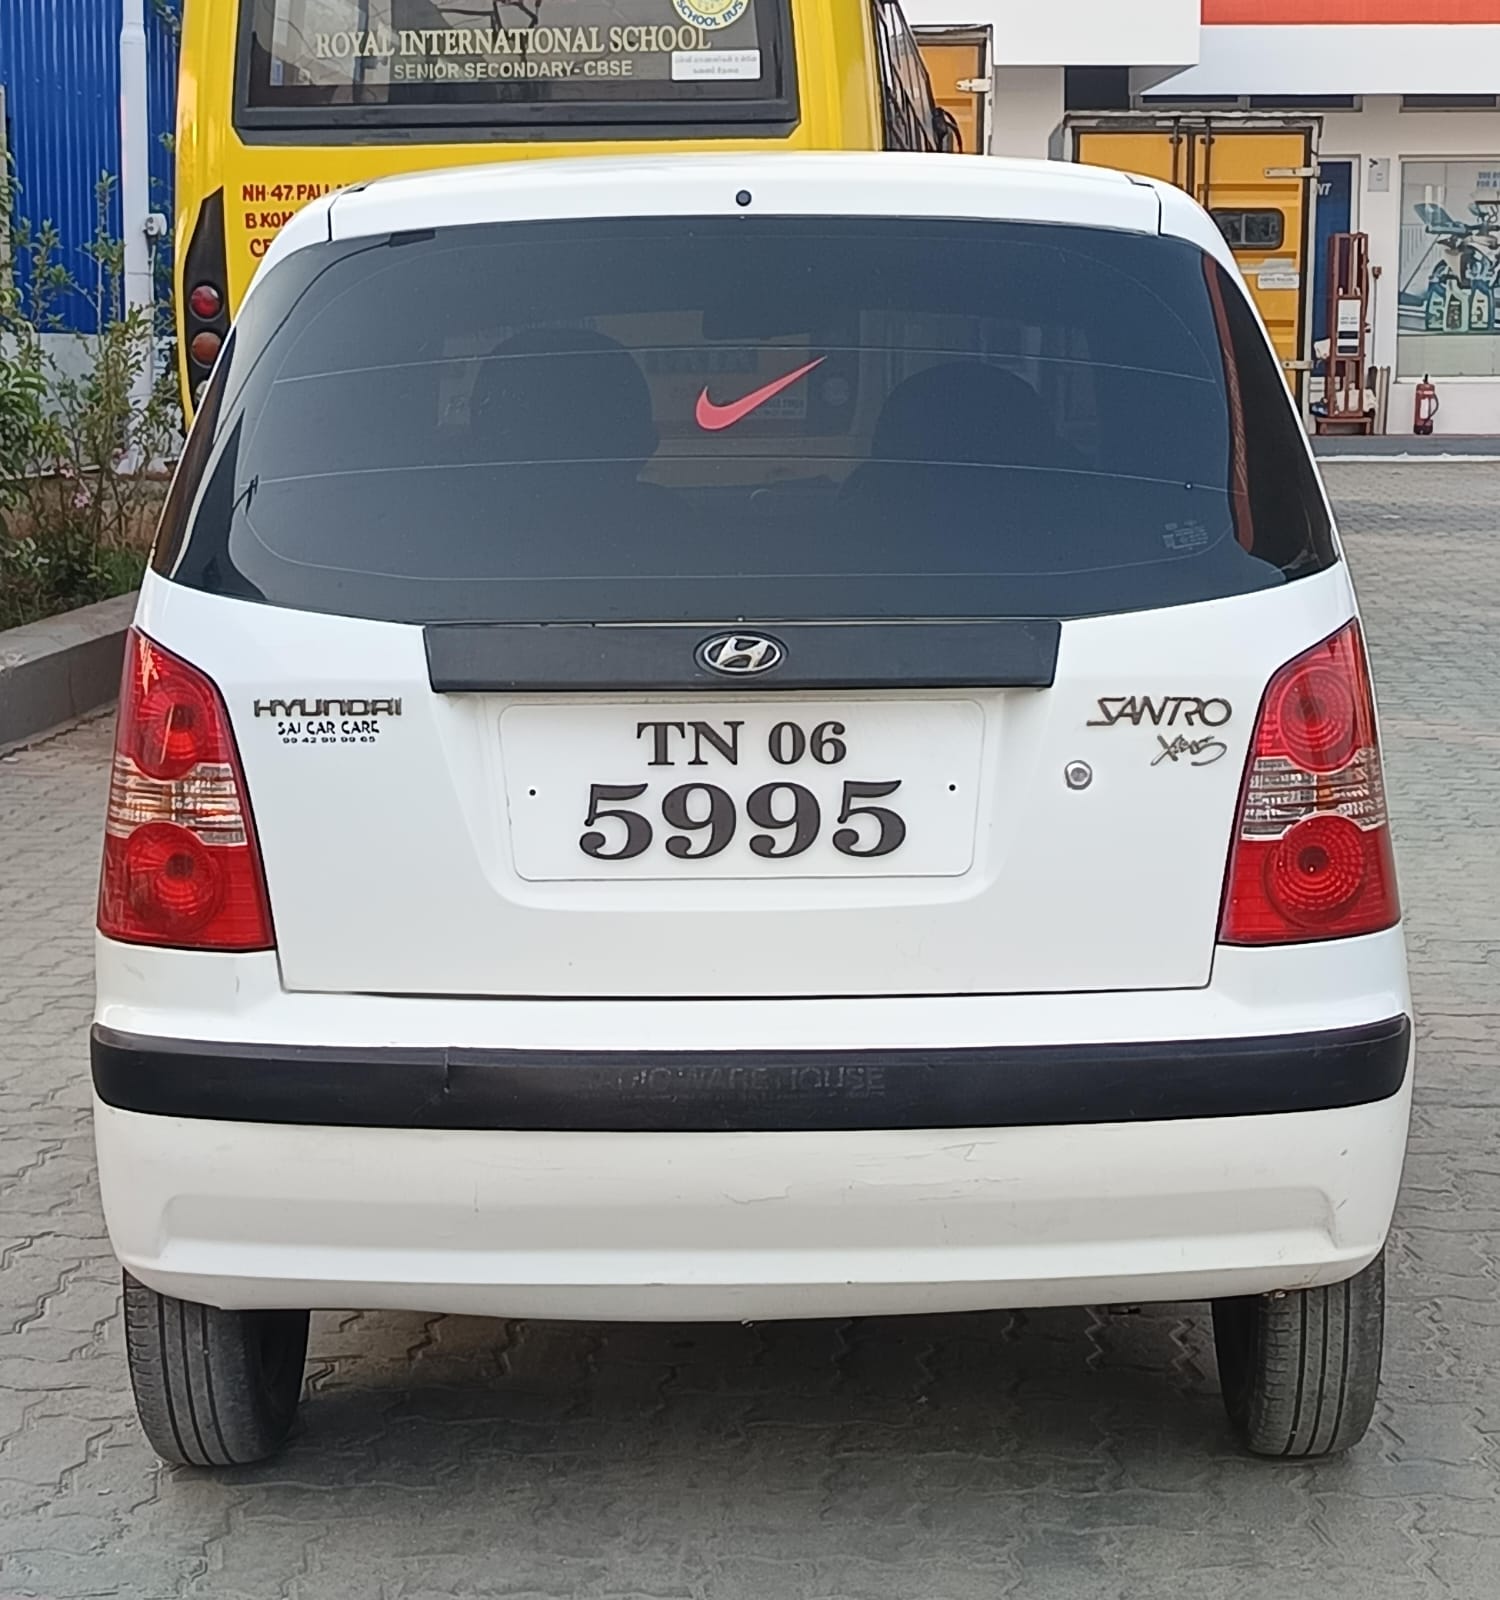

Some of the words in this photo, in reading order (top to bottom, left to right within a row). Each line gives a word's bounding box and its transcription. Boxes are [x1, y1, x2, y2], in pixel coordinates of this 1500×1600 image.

[676, 1, 720, 27] SCHOOL
[315, 30, 395, 58] ROYAL
[399, 26, 605, 56] INTERNATIONAL
[609, 24, 712, 52] SCHOOL
[394, 63, 459, 80] SENIOR
[254, 697, 402, 717] HYUNDAI
[1086, 695, 1232, 727] SANTRO
[278, 720, 301, 736] SAI
[306, 720, 336, 735] CAR
[341, 720, 380, 735] CARE
[636, 721, 745, 766] TN
[767, 721, 847, 765] 06
[579, 779, 907, 860] 5995
